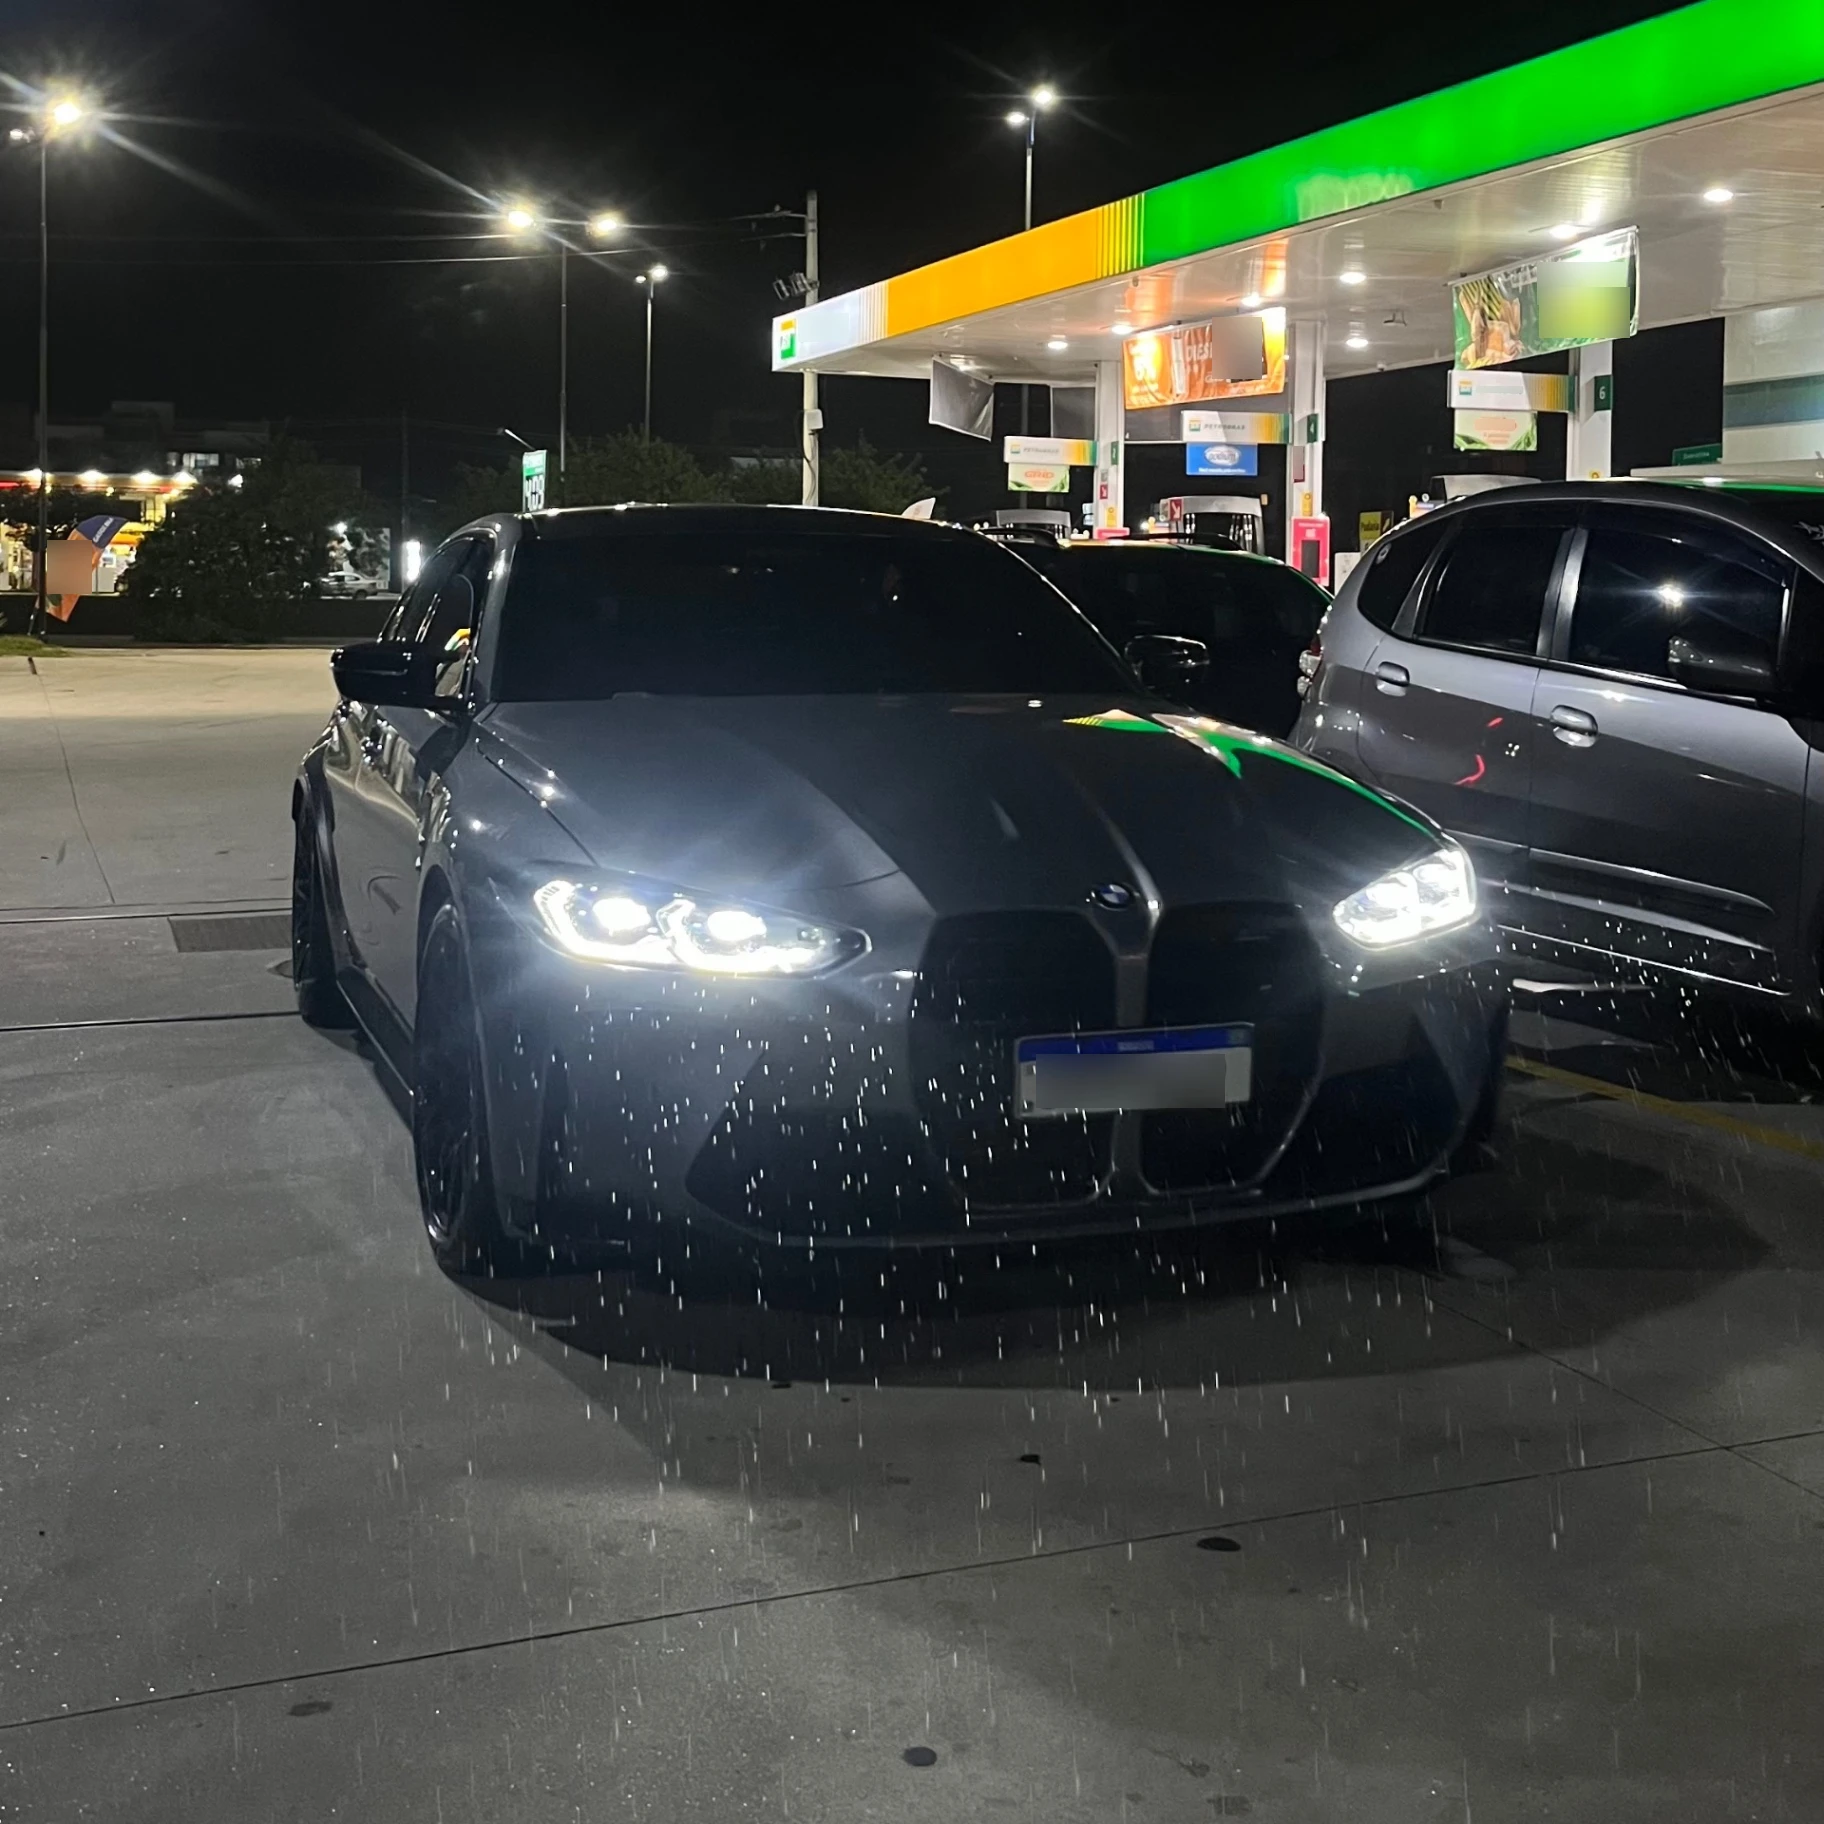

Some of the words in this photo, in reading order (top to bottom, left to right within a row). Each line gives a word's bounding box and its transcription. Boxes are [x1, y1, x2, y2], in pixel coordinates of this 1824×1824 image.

[1599, 386, 1606, 400] 6
[1203, 423, 1246, 431] PETROBRAS
[1024, 470, 1055, 480] GRID
